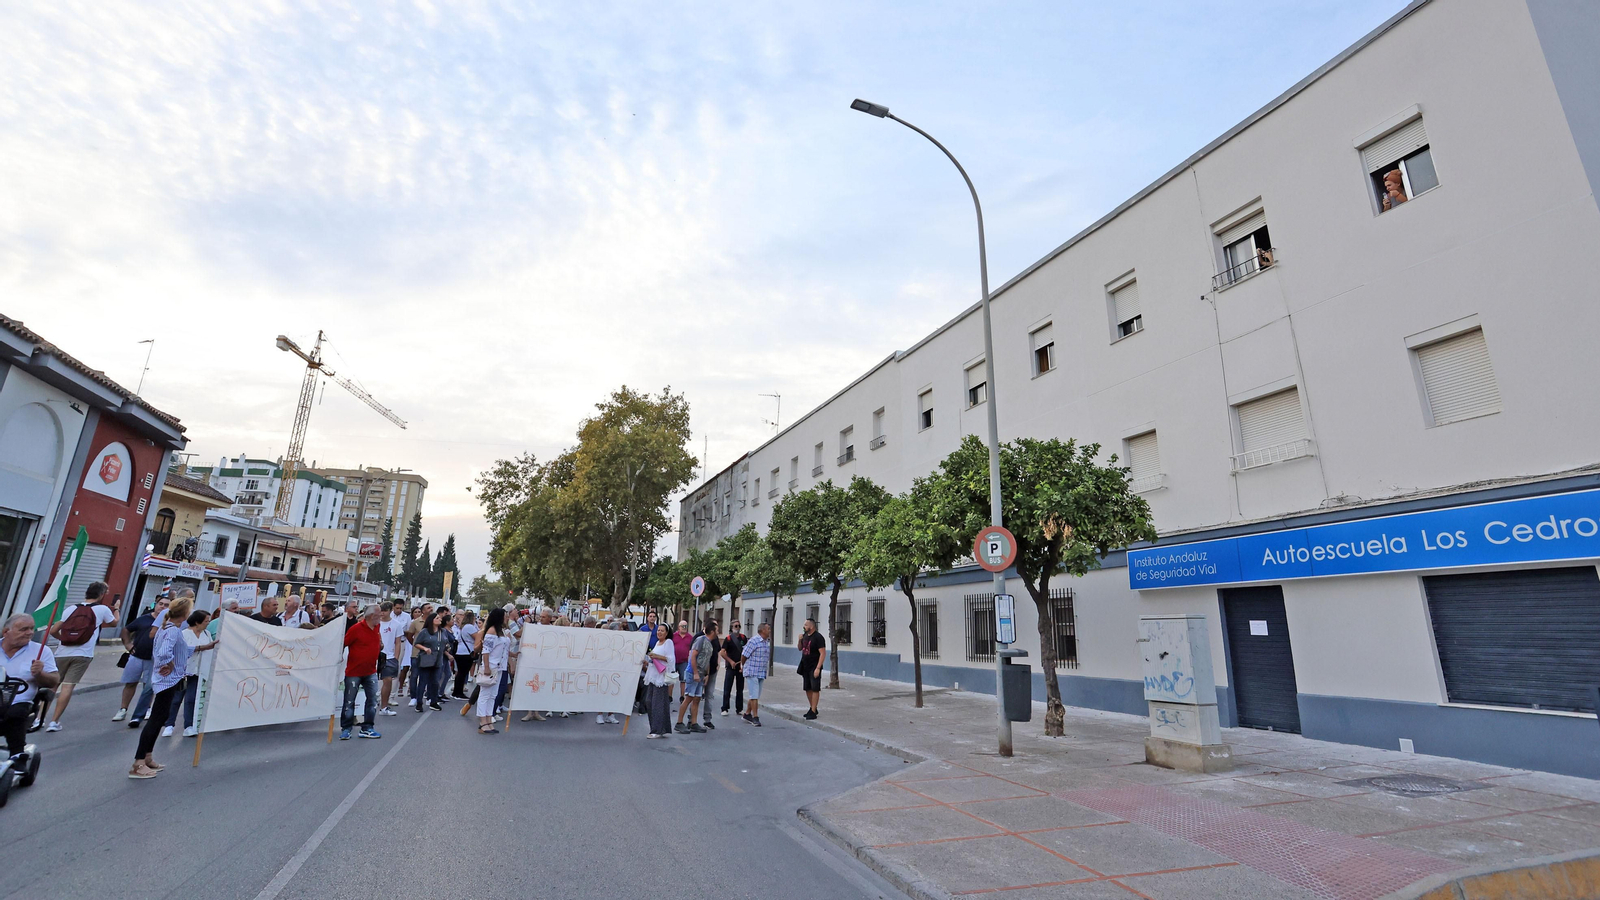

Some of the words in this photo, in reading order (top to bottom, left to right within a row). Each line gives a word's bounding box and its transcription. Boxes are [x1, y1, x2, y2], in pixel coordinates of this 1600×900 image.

[990, 543, 999, 554] P
[1262, 533, 1408, 566] Autoescuela
[1421, 529, 1468, 551] Los
[1484, 515, 1600, 545] Cedro
[1134, 556, 1167, 567] Instituto
[1169, 551, 1208, 564] Andaluz
[1136, 571, 1148, 581] de
[1149, 565, 1196, 581] Seguridad
[1198, 563, 1217, 575] Vial
[245, 632, 321, 662] OBRAS
[538, 630, 644, 666] PALABRAS
[236, 676, 310, 712] RUINA
[551, 671, 621, 696] HECHOS
